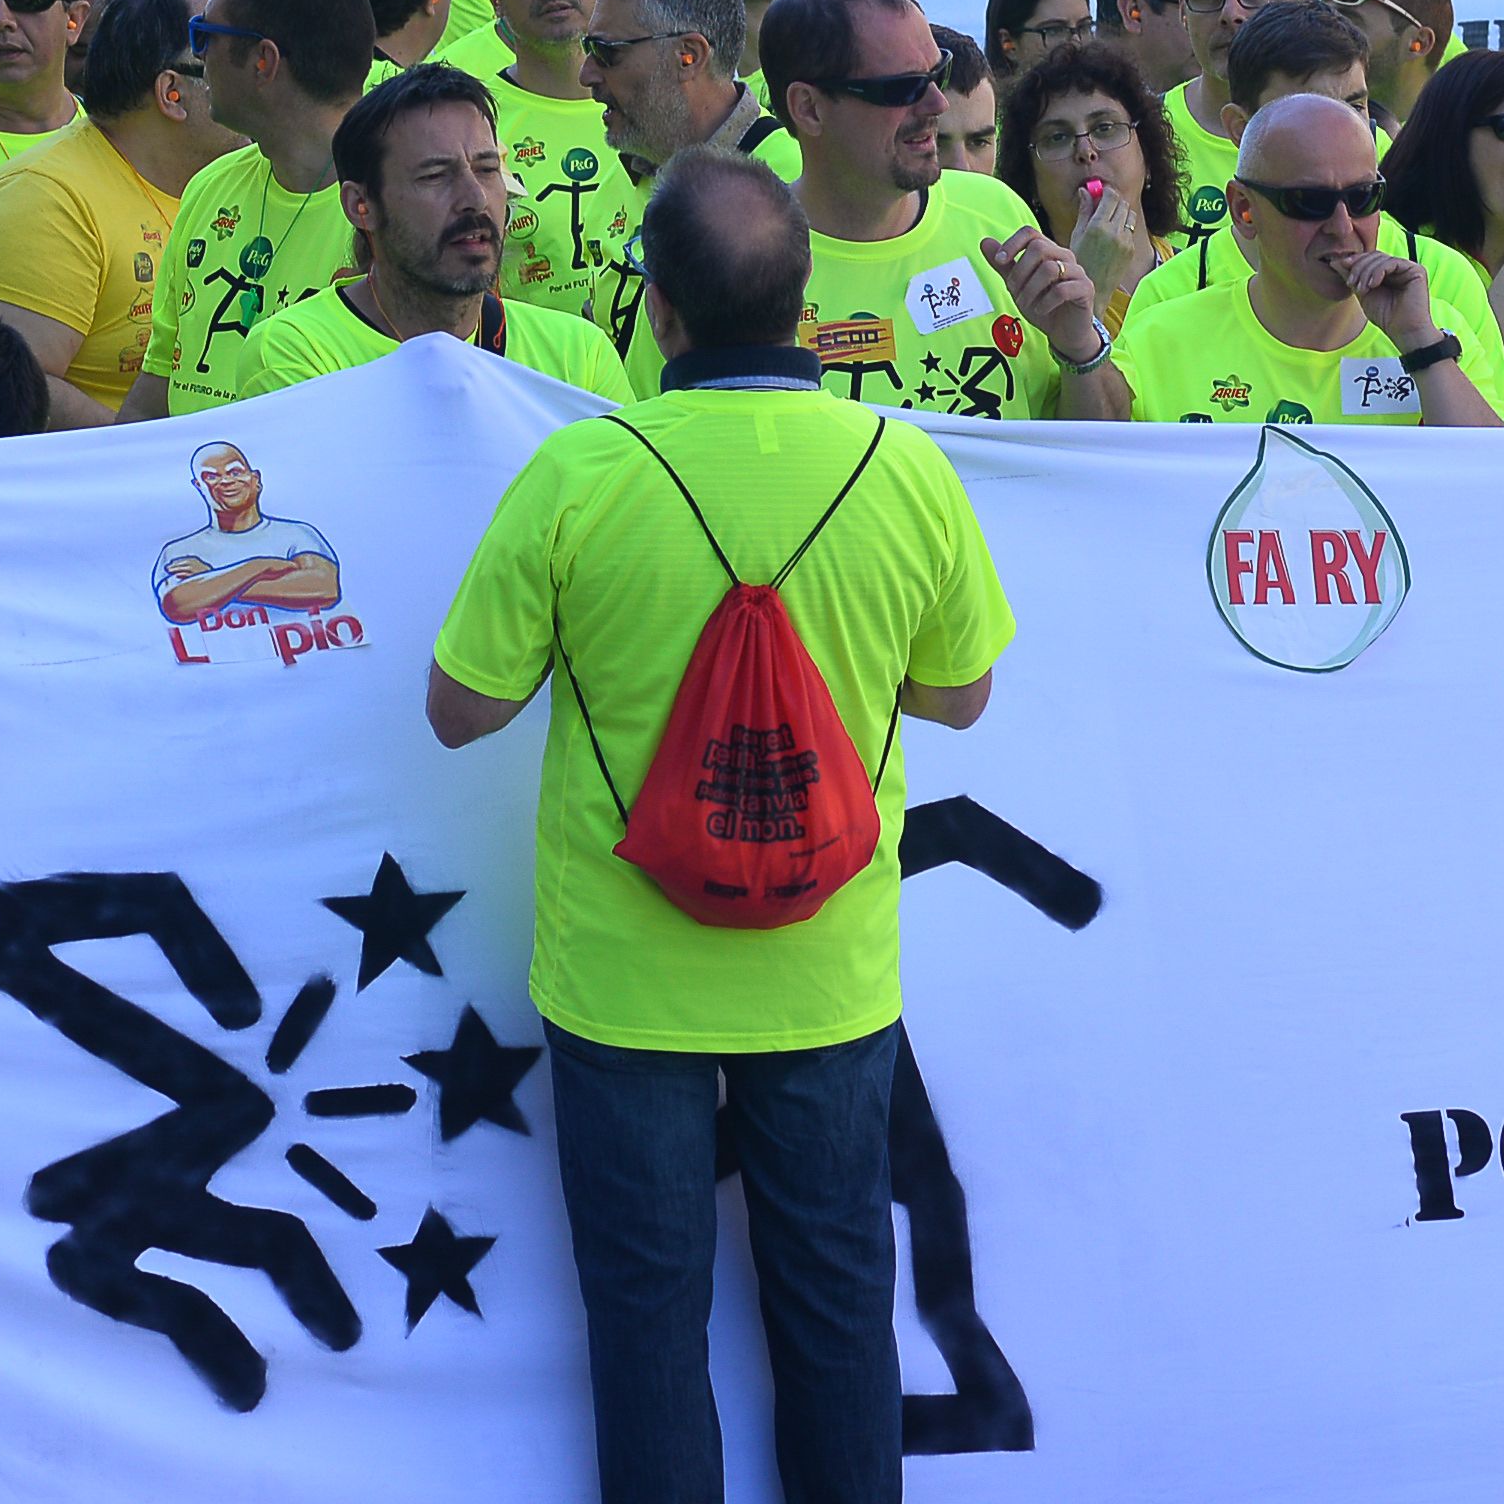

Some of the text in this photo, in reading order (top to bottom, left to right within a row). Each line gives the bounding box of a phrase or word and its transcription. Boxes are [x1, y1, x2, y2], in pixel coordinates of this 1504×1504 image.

[516, 146, 544, 159] ARIEL
[570, 157, 595, 173] P&G
[1195, 198, 1223, 212] P&G
[214, 216, 237, 230] ARIE
[247, 249, 271, 267] P&G
[573, 278, 590, 289] FUT
[816, 329, 879, 346] CCOO
[1211, 386, 1249, 400] ARIEL
[196, 606, 270, 633] Don
